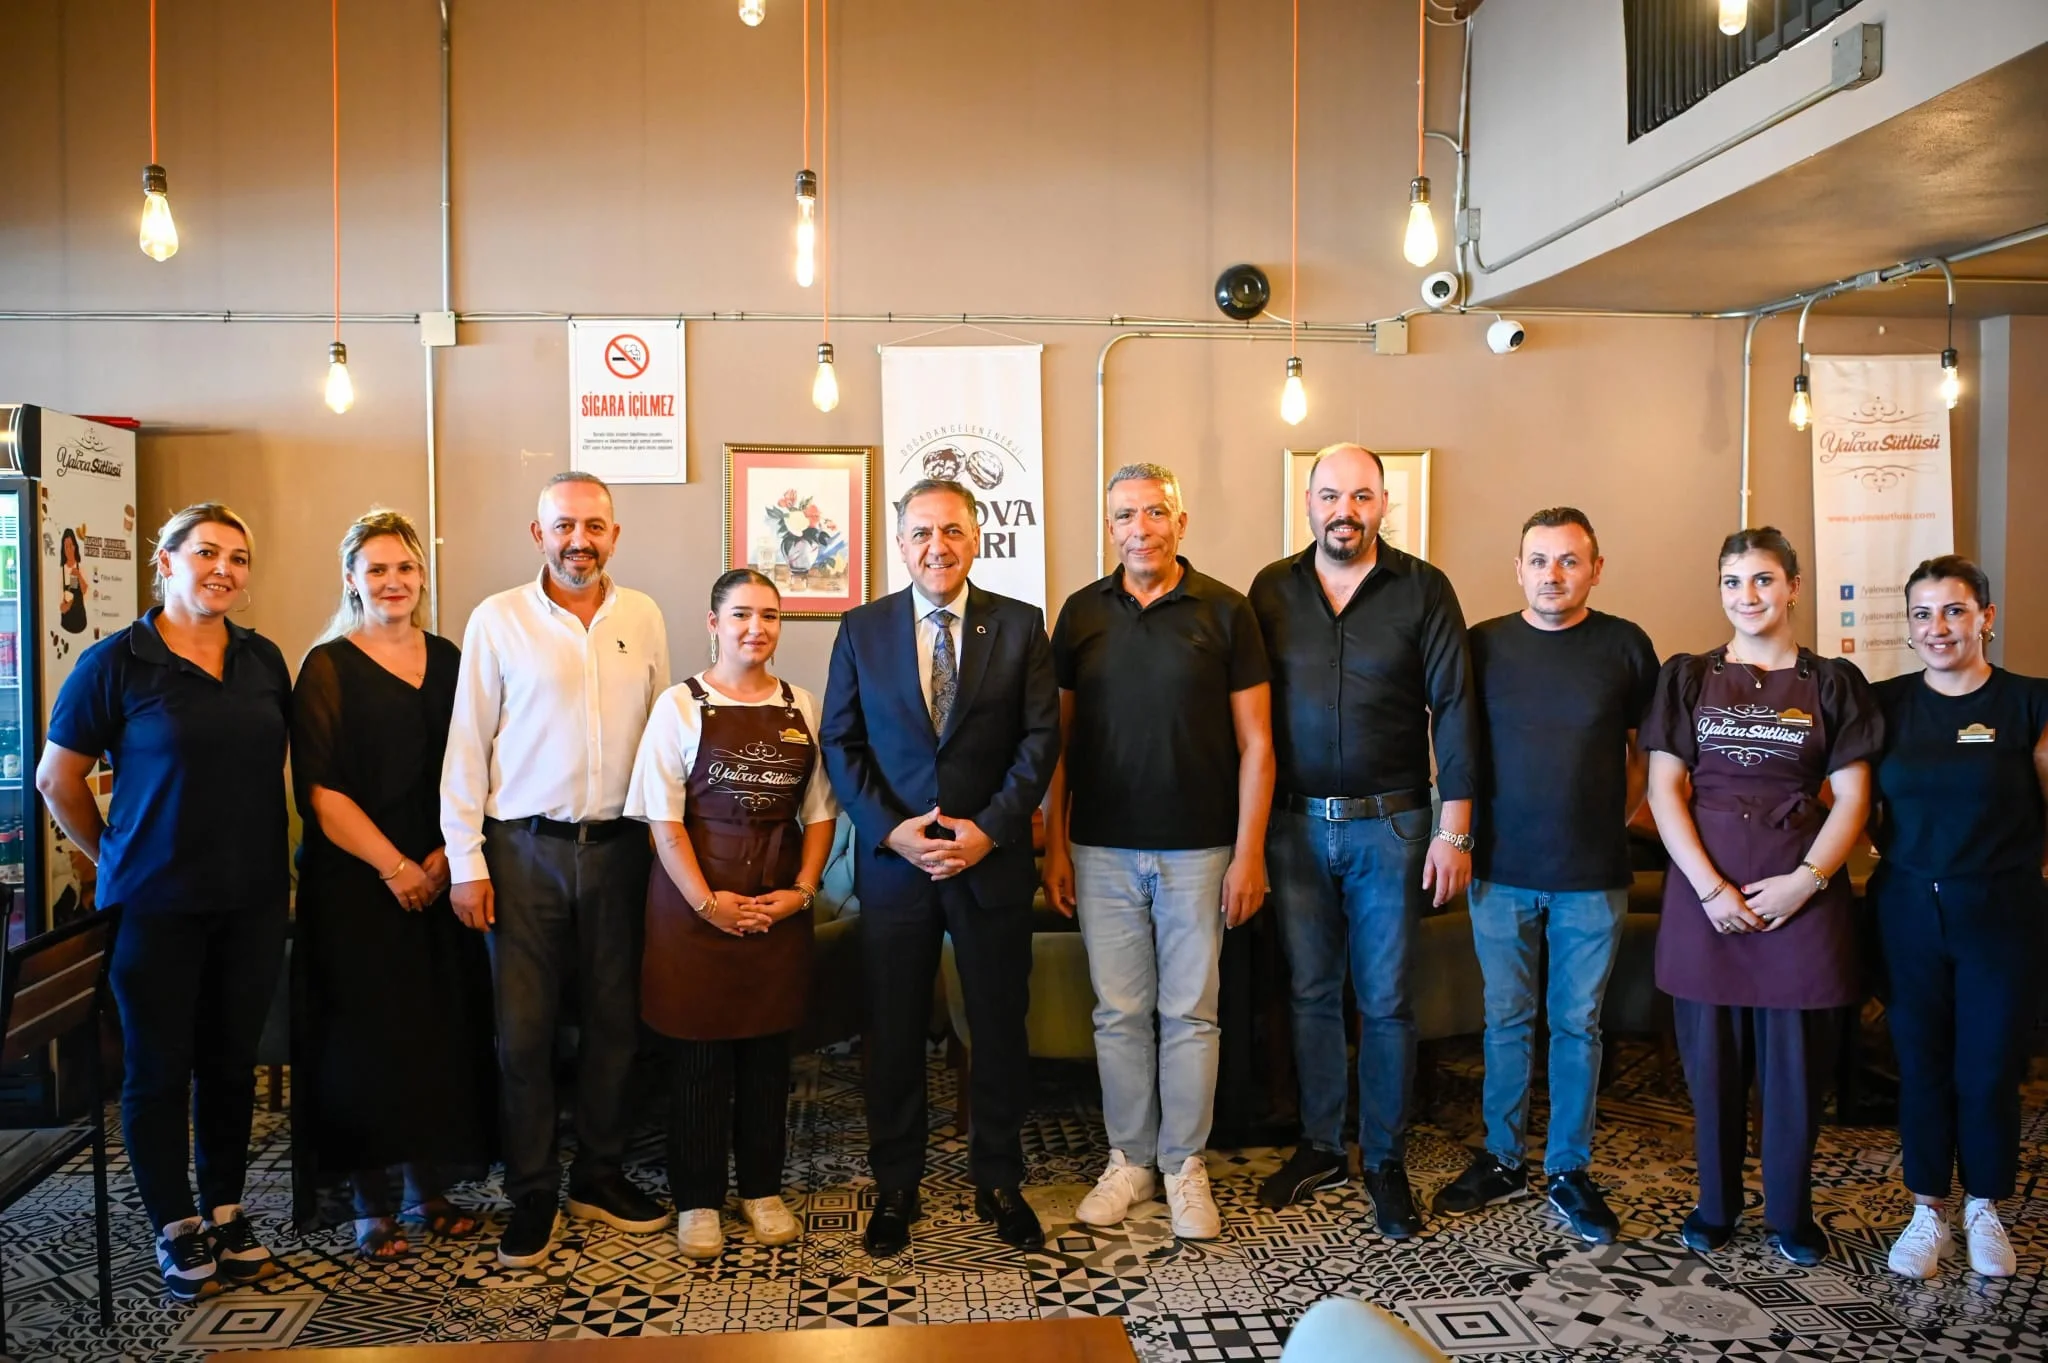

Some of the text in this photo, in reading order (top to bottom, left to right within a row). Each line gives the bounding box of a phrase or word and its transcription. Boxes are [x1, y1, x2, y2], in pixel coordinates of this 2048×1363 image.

[582, 391, 674, 420] SİGARA İÇİLMEZ
[950, 423, 985, 435] GELEN
[1819, 431, 1941, 463] Yalova Sütlüsü
[1698, 717, 1805, 744] Yalova Sütlüsü
[708, 761, 761, 785] Yalova
